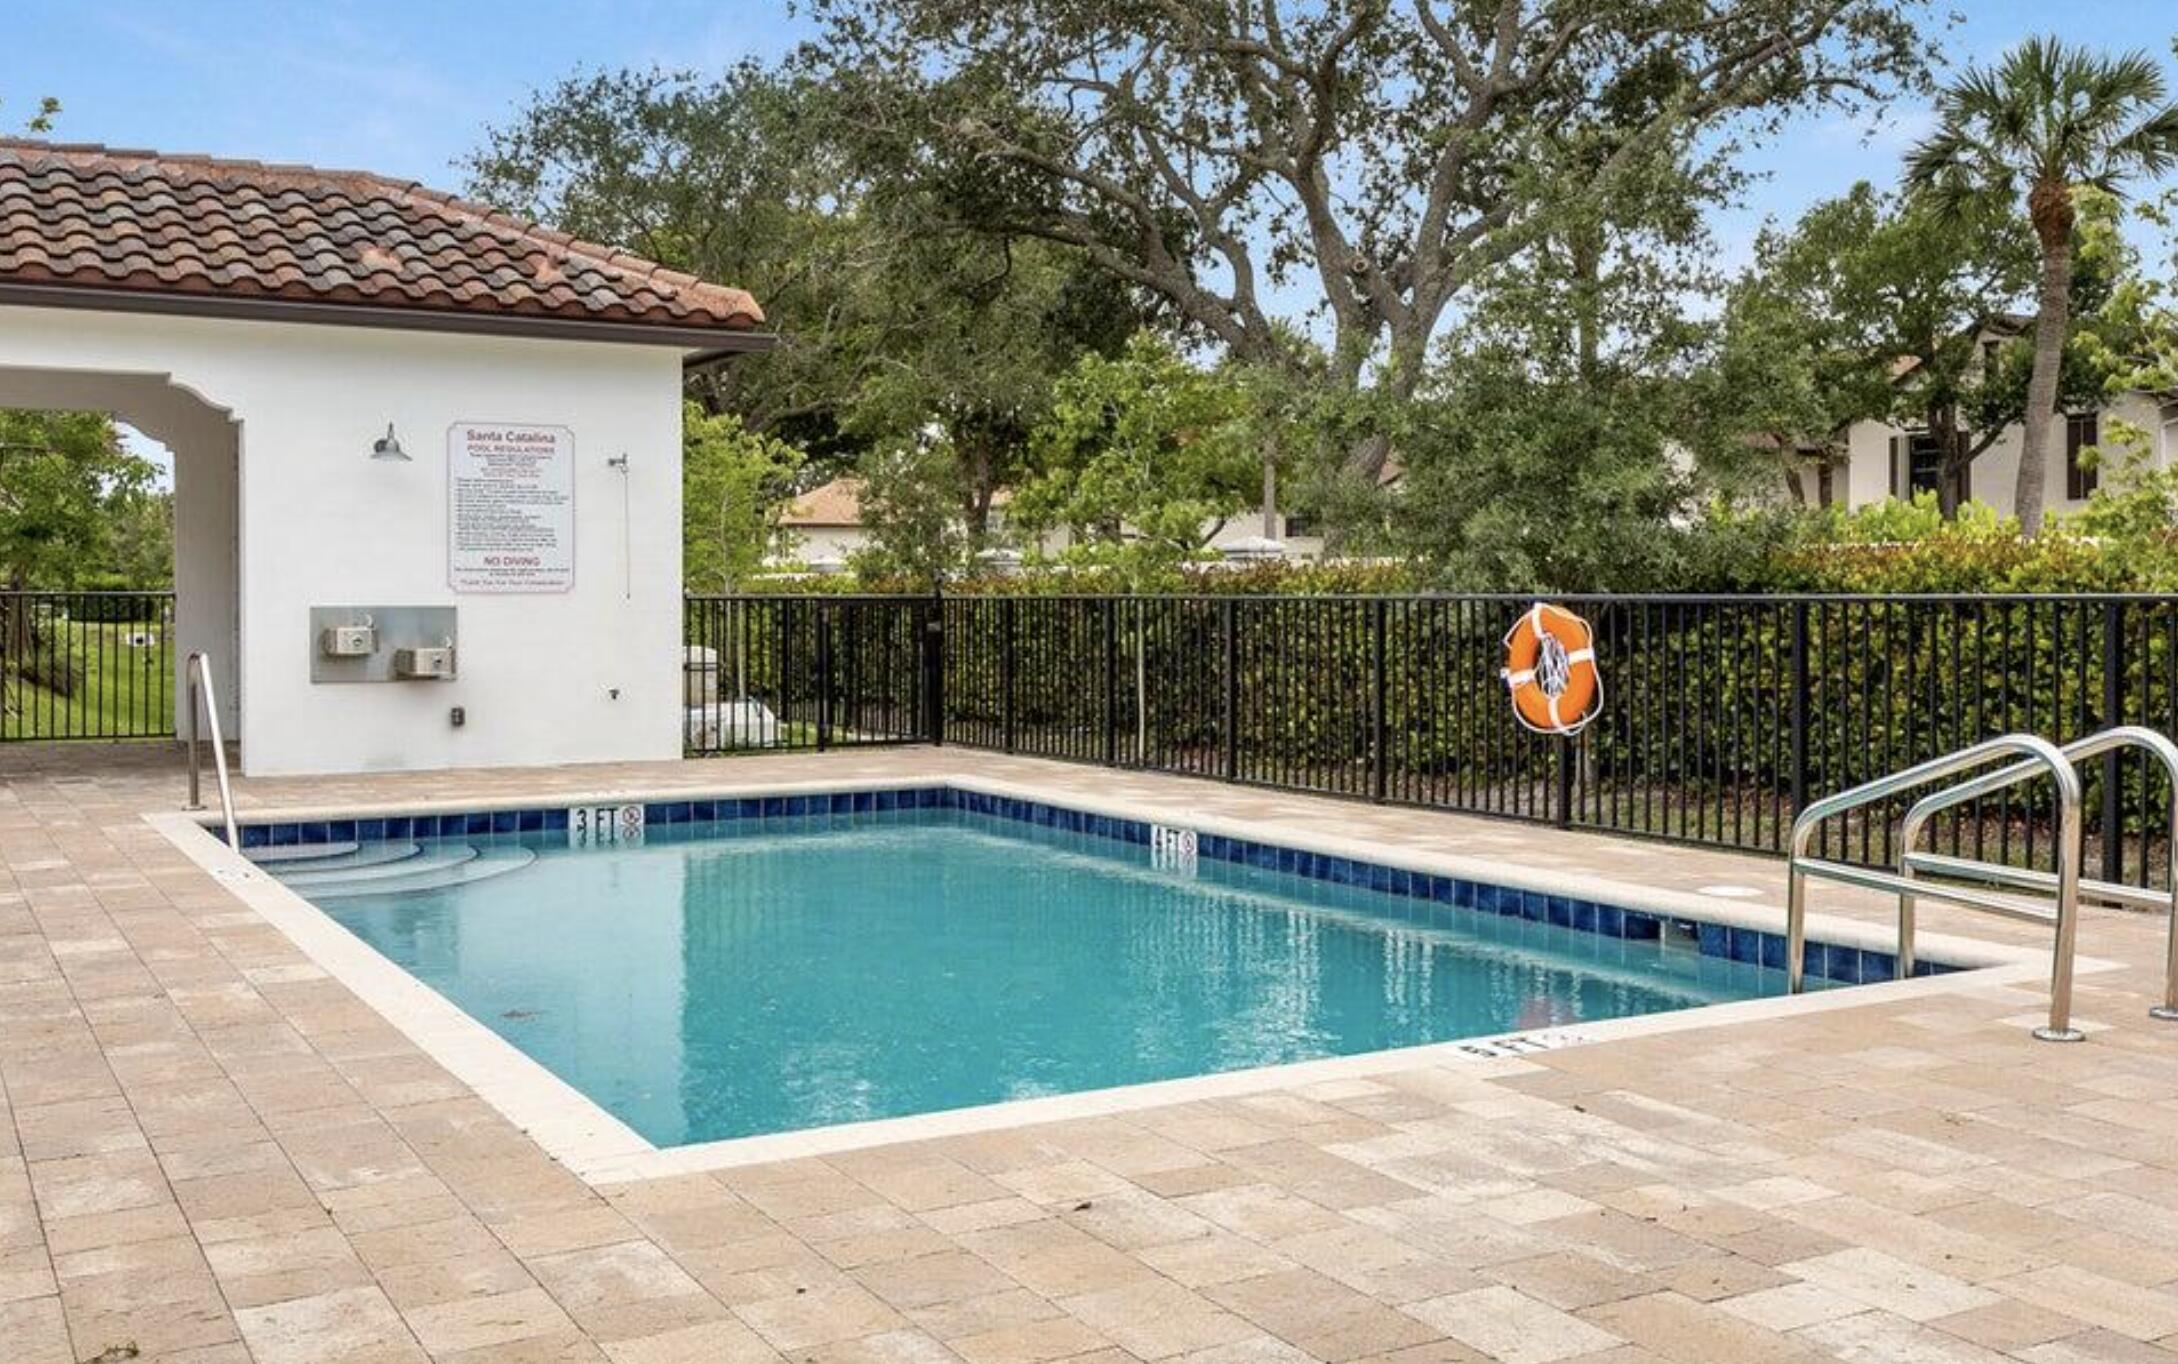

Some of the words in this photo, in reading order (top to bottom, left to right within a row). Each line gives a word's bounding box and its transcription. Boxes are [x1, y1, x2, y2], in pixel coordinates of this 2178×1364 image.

[467, 429, 502, 441] Santa
[506, 431, 555, 443] Catalina
[484, 557, 500, 565] NO
[503, 557, 541, 566] DIVING
[576, 808, 587, 832] 3
[595, 807, 618, 832] FT
[1156, 827, 1162, 847] 4
[1166, 828, 1180, 850] FT
[1459, 1046, 1498, 1057] 5
[1492, 1037, 1549, 1053] FT
